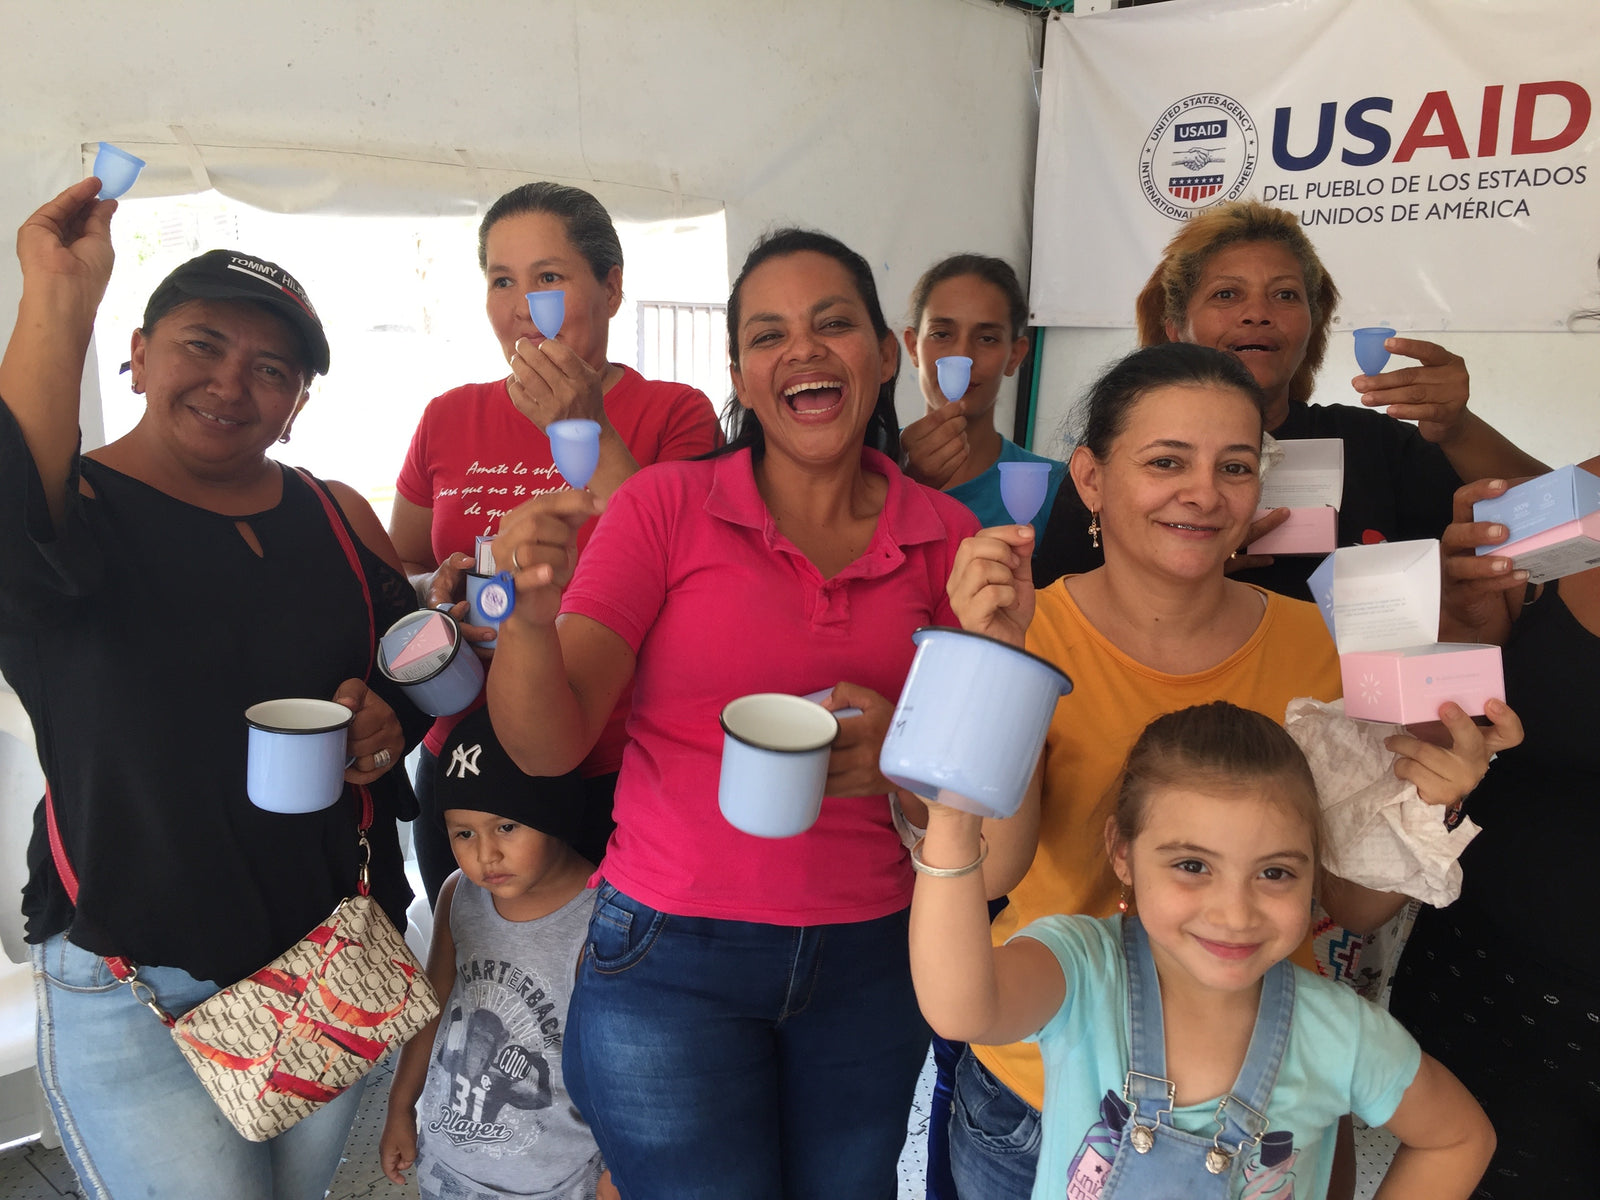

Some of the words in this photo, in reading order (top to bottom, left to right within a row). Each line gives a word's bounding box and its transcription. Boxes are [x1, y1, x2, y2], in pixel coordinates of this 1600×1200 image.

[1150, 105, 1181, 142] UNITED
[1182, 95, 1220, 109] STATES
[1219, 99, 1253, 133] AGENCY
[1179, 123, 1222, 139] USAID
[1272, 80, 1592, 172] USAID
[1263, 184, 1299, 203] DEL
[1305, 178, 1384, 200] PUEBLO
[1391, 175, 1421, 194] DE
[1427, 172, 1471, 193] LOS
[1477, 165, 1587, 190] ESTADOS
[1301, 206, 1384, 227] UNIDOS
[1391, 203, 1420, 223] DE
[1425, 197, 1531, 221] AMÉRICA
[230, 256, 278, 278] TOMMY
[465, 460, 509, 476] Amate
[512, 461, 528, 475] lo
[461, 484, 484, 499] que
[487, 486, 508, 496] no
[512, 484, 526, 496] te
[464, 501, 481, 516] de
[446, 743, 482, 778] NY
[452, 1072, 487, 1123] 31
[428, 1104, 514, 1144] Player
